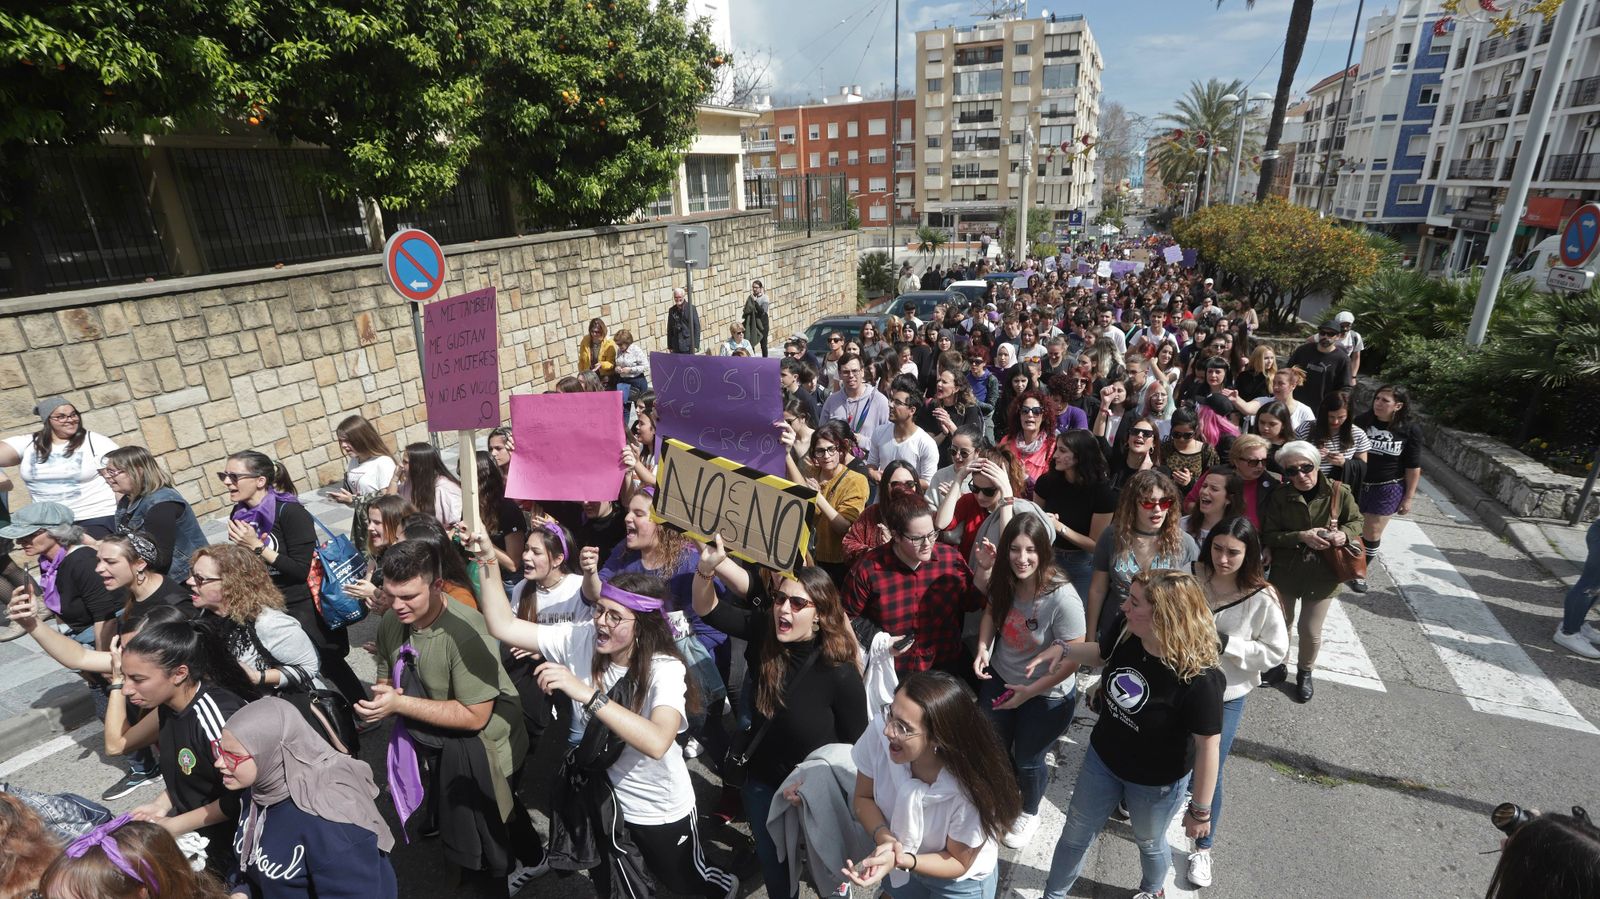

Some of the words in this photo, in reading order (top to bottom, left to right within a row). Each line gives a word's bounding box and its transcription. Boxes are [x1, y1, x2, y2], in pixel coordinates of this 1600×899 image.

[1072, 213, 1079, 222] P
[426, 311, 434, 329] A
[440, 303, 456, 322] MI
[429, 336, 443, 355] ME
[446, 328, 486, 351] GUSTAN
[431, 358, 451, 380] LAS
[454, 349, 497, 374] MUJERES
[656, 360, 701, 394] YO
[428, 391, 434, 409] Y
[439, 388, 450, 403] NO
[451, 383, 467, 402] LAS
[470, 380, 498, 396] VIOLO
[698, 426, 777, 455] CREO
[660, 457, 726, 535] NO
[719, 480, 747, 543] ES
[742, 485, 804, 570] NO
